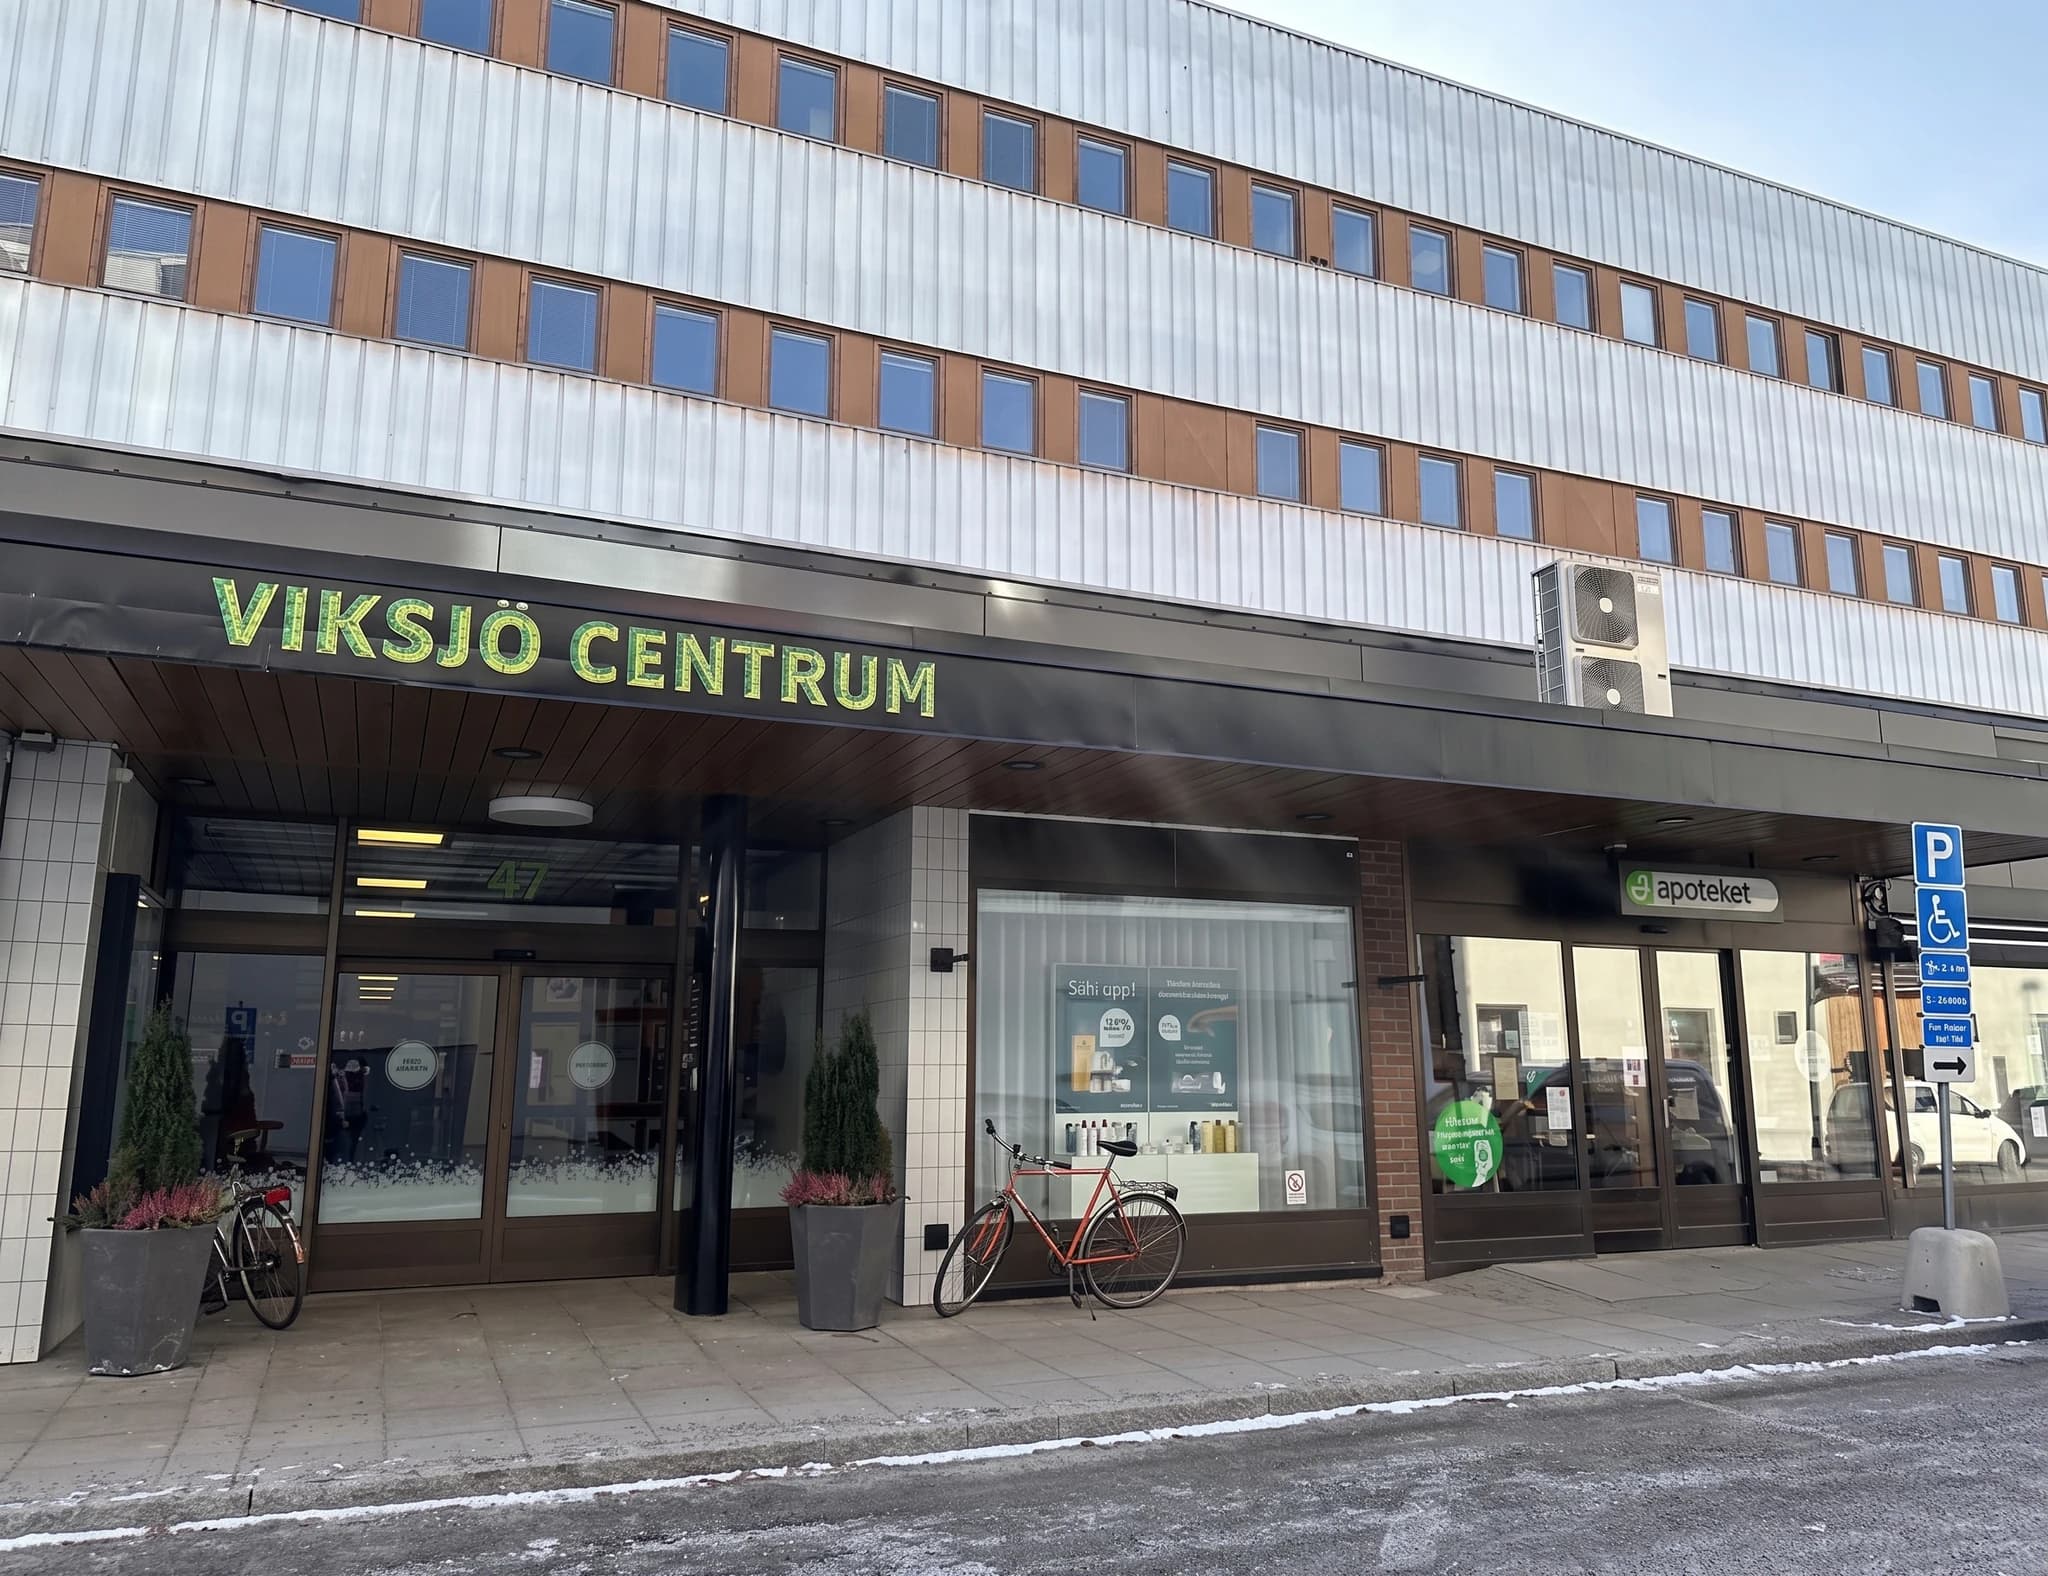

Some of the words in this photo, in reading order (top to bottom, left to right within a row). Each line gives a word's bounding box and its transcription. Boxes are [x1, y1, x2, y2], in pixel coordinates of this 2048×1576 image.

[211, 576, 543, 676] VIKSJÖ
[570, 620, 936, 718] CENTRUM
[1927, 831, 1953, 878] P
[487, 860, 548, 900] 47
[1657, 879, 1752, 905] apoteket
